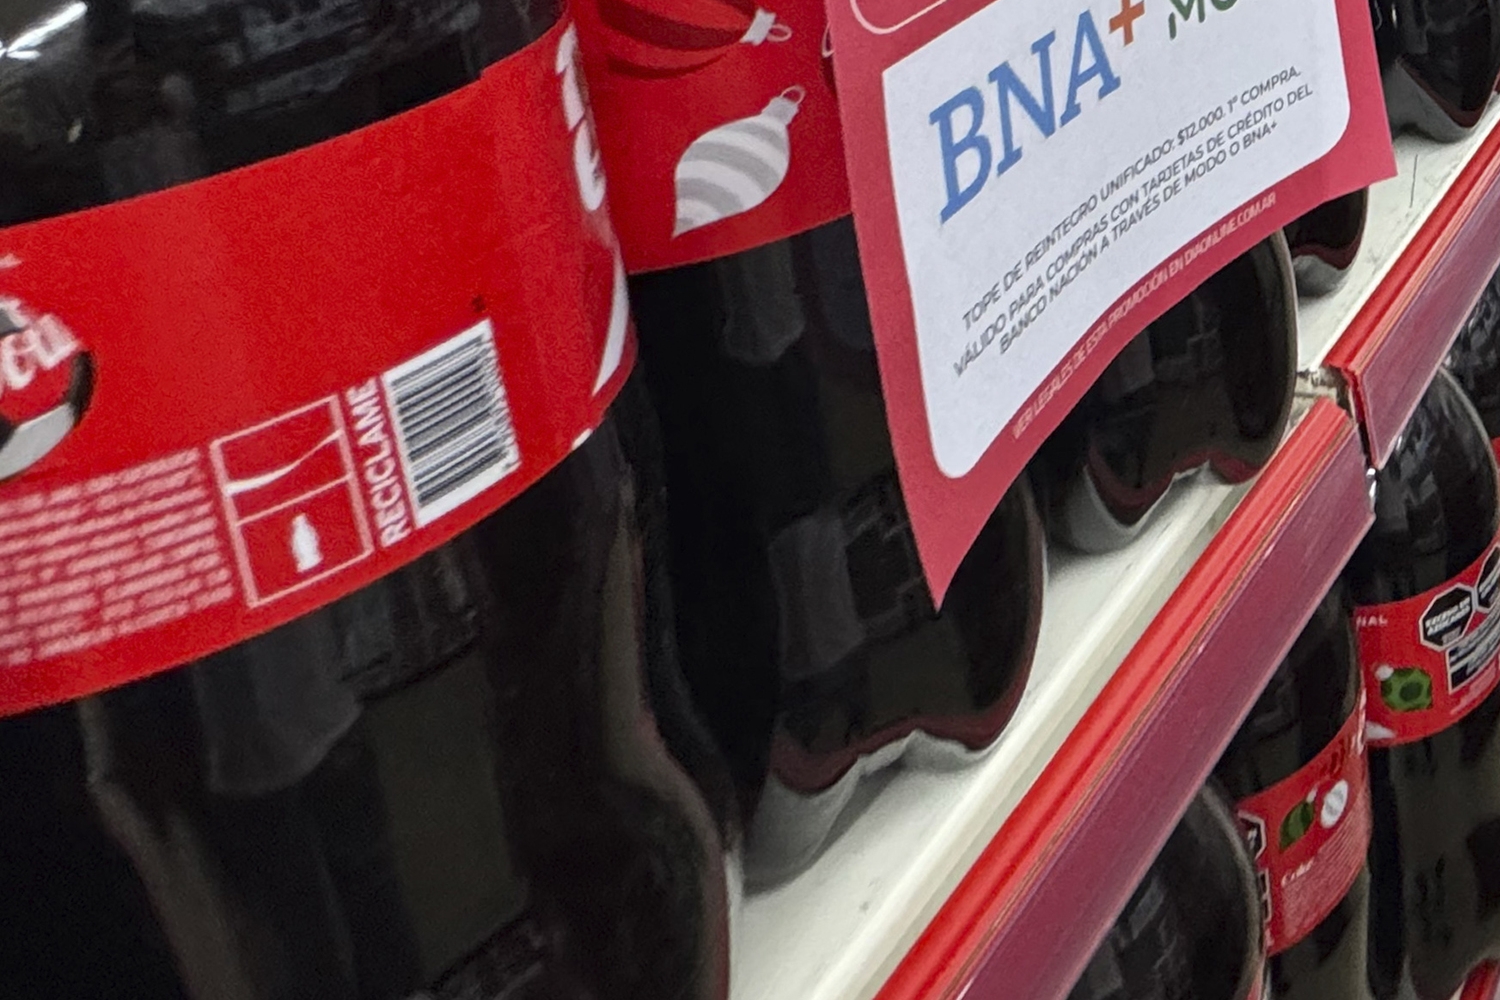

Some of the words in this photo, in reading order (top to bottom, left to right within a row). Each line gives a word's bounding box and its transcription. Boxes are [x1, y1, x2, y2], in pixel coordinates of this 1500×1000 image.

[952, 312, 1007, 378] VÁLIDO
[1008, 274, 1045, 321] PARA
[1046, 212, 1109, 282] COMPRAS
[1110, 189, 1140, 222] CON
[1142, 143, 1205, 197] TARJETAS
[1206, 131, 1226, 155] DE
[1227, 97, 1285, 139] CRÉDITO
[1287, 83, 1314, 107] DEL
[961, 281, 1001, 332] TOPE
[1002, 260, 1023, 293] DE
[1024, 193, 1099, 272] REINTEGRO
[999, 294, 1048, 355] BANCO
[1049, 242, 1098, 303] NACIÓN
[1099, 239, 1110, 254] A
[1111, 191, 1161, 242] TRAVÉS
[1162, 181, 1184, 203] DE
[1184, 149, 1228, 188] MODO
[1229, 140, 1241, 157] O
[345, 375, 415, 549] RECICLAME
